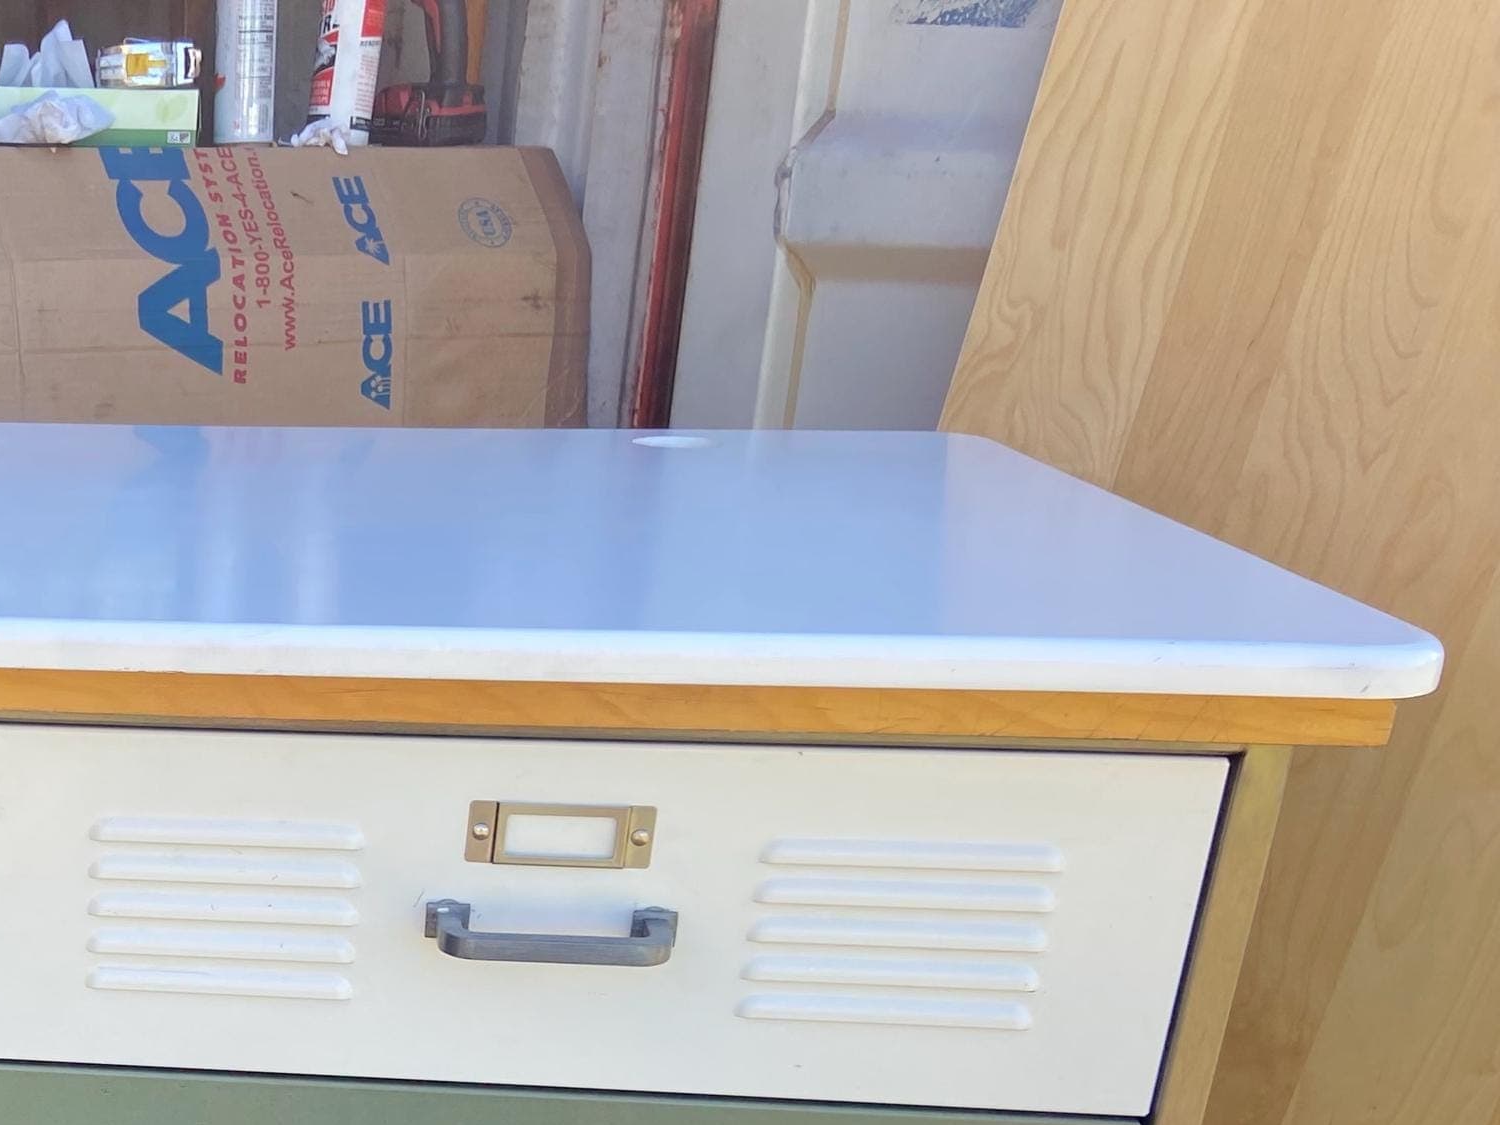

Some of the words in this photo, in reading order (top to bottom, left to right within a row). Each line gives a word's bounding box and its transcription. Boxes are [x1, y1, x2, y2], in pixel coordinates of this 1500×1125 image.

[216, 146, 271, 308] 1-800-YES-4-ACE
[332, 176, 390, 265] ACE
[476, 210, 497, 236] USA
[216, 213, 248, 384] RELOCATION
[360, 300, 393, 410] ACE
